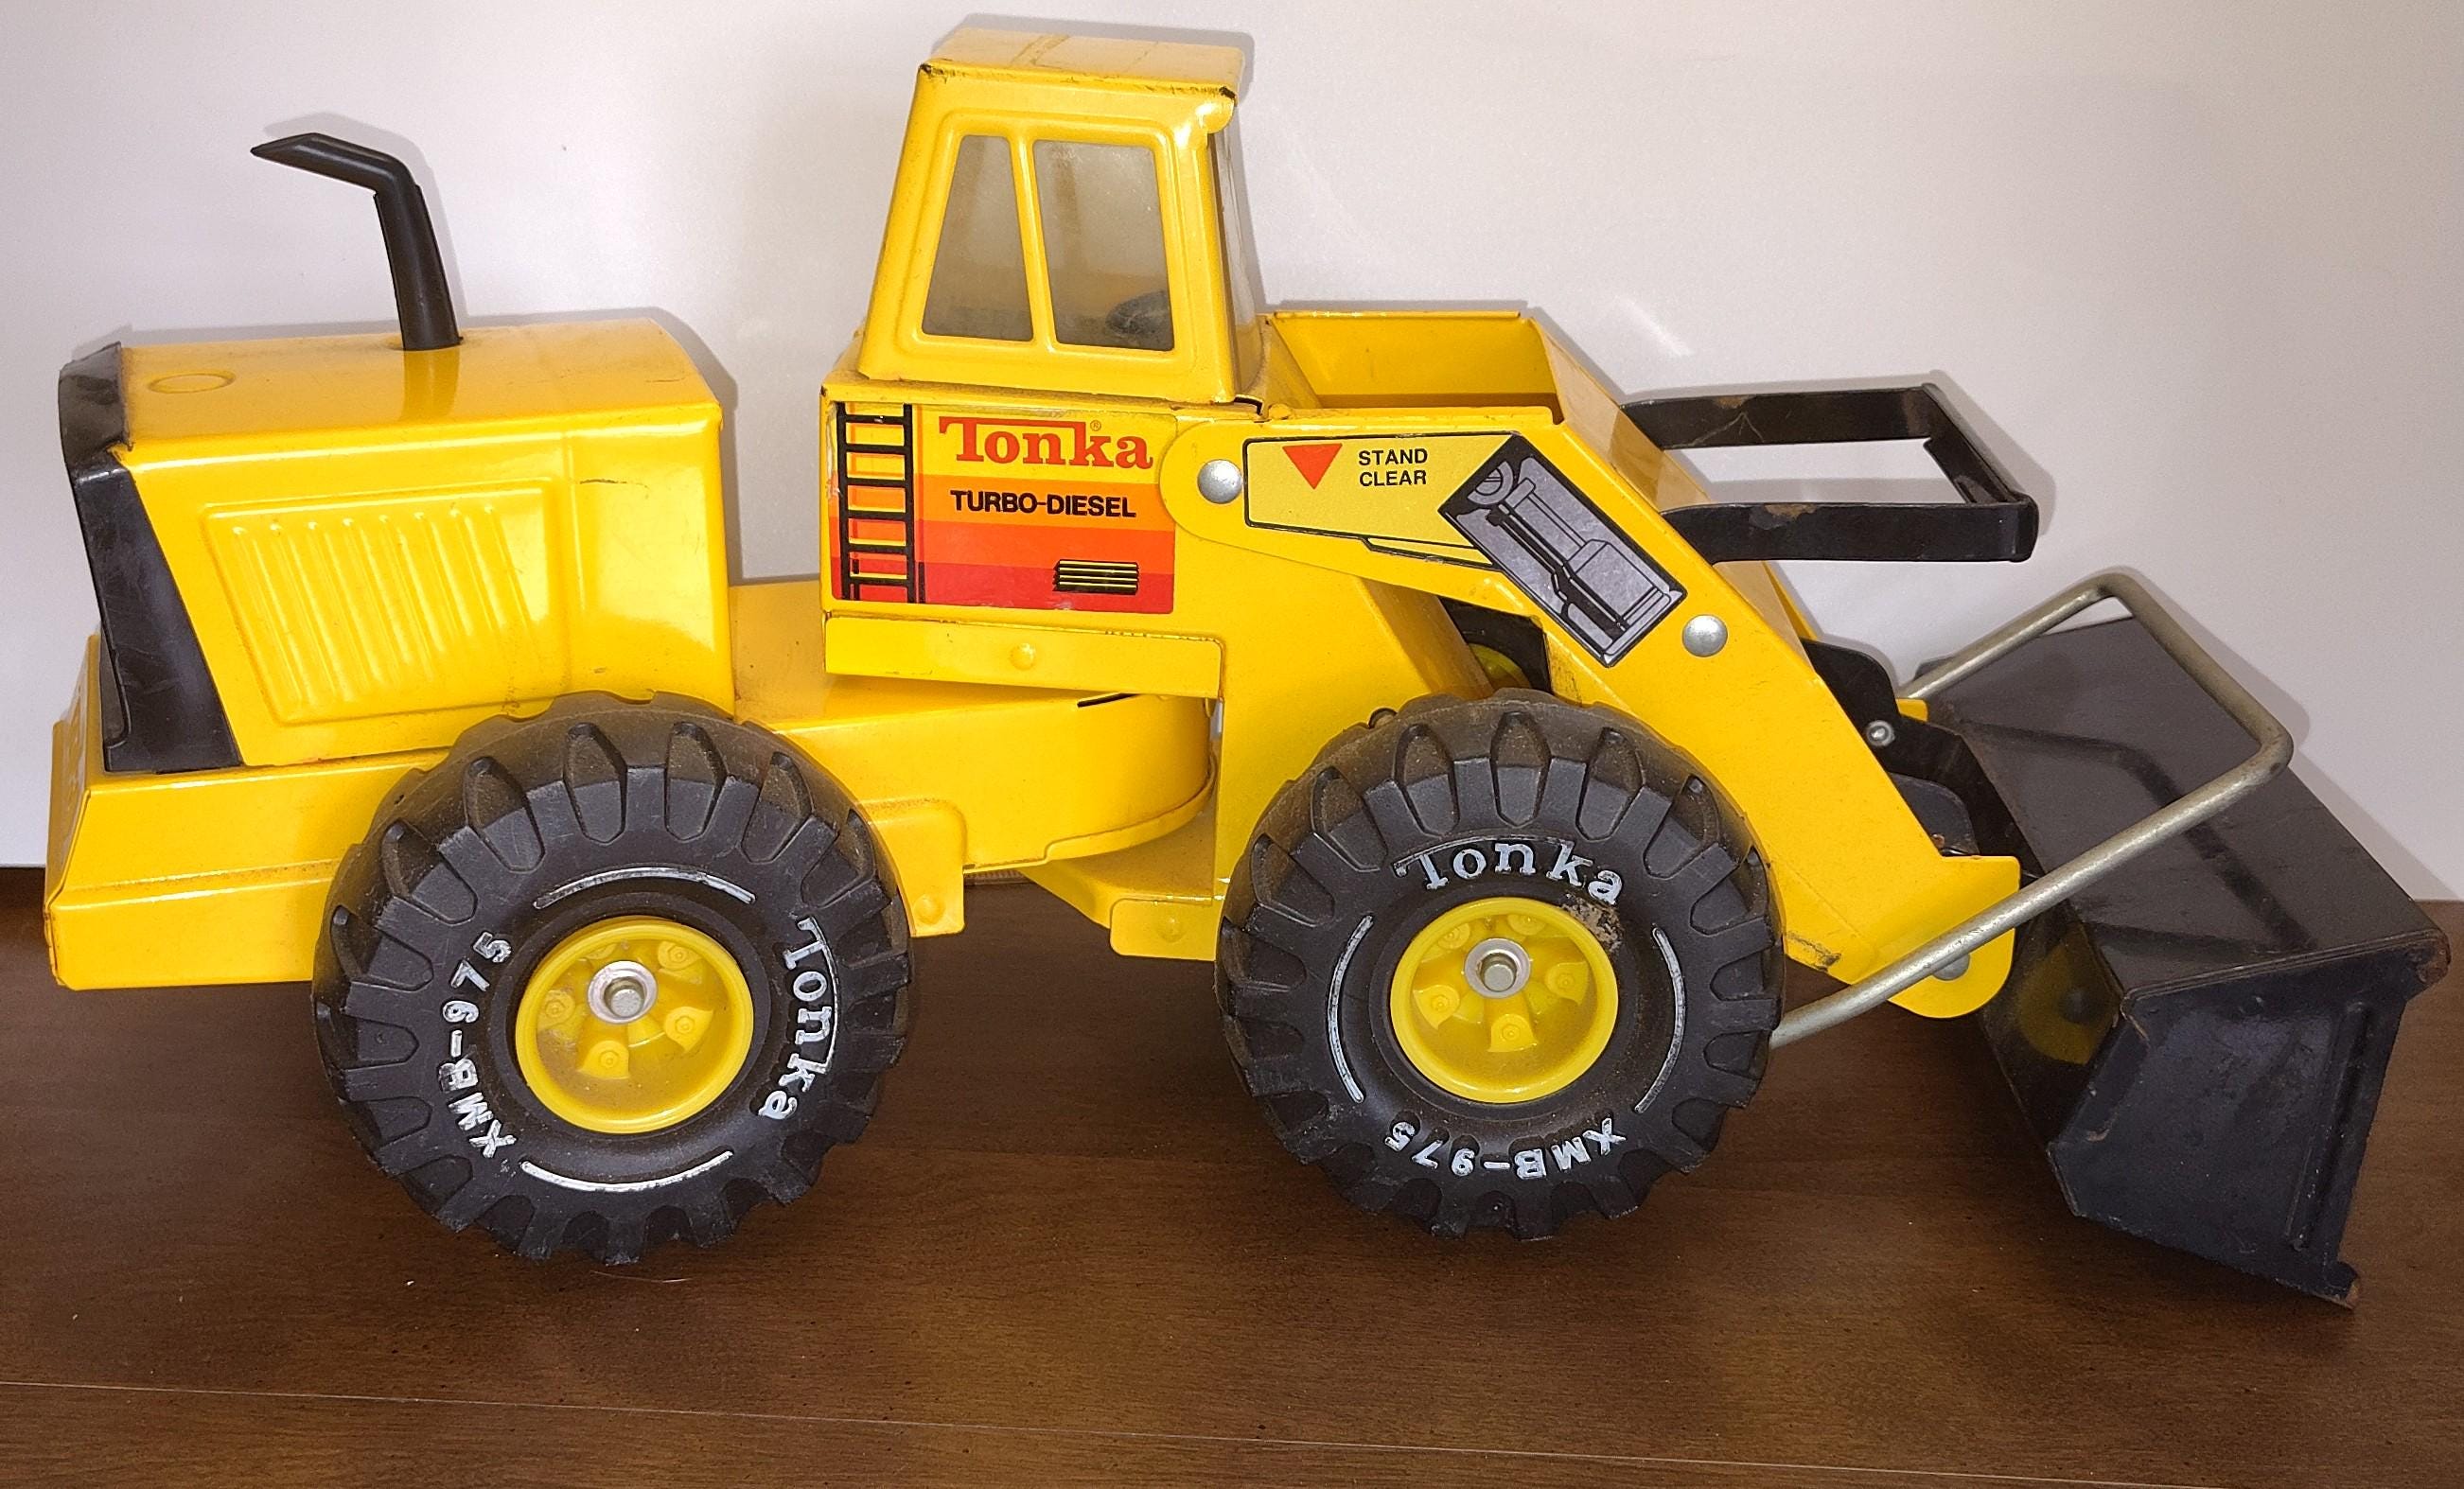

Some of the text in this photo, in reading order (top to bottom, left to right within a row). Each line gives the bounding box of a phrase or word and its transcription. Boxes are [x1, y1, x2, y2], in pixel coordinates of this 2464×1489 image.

[939, 416, 1153, 469] Tonka
[1358, 447, 1429, 466] STAND
[951, 490, 1136, 517] TURBO-DIESEL
[1359, 469, 1427, 487] CLEAR
[1394, 833, 1624, 905] Tonka
[438, 932, 516, 1158] XMB-975
[759, 916, 840, 1121] Tonka
[1384, 1117, 1626, 1180] XMB-975
